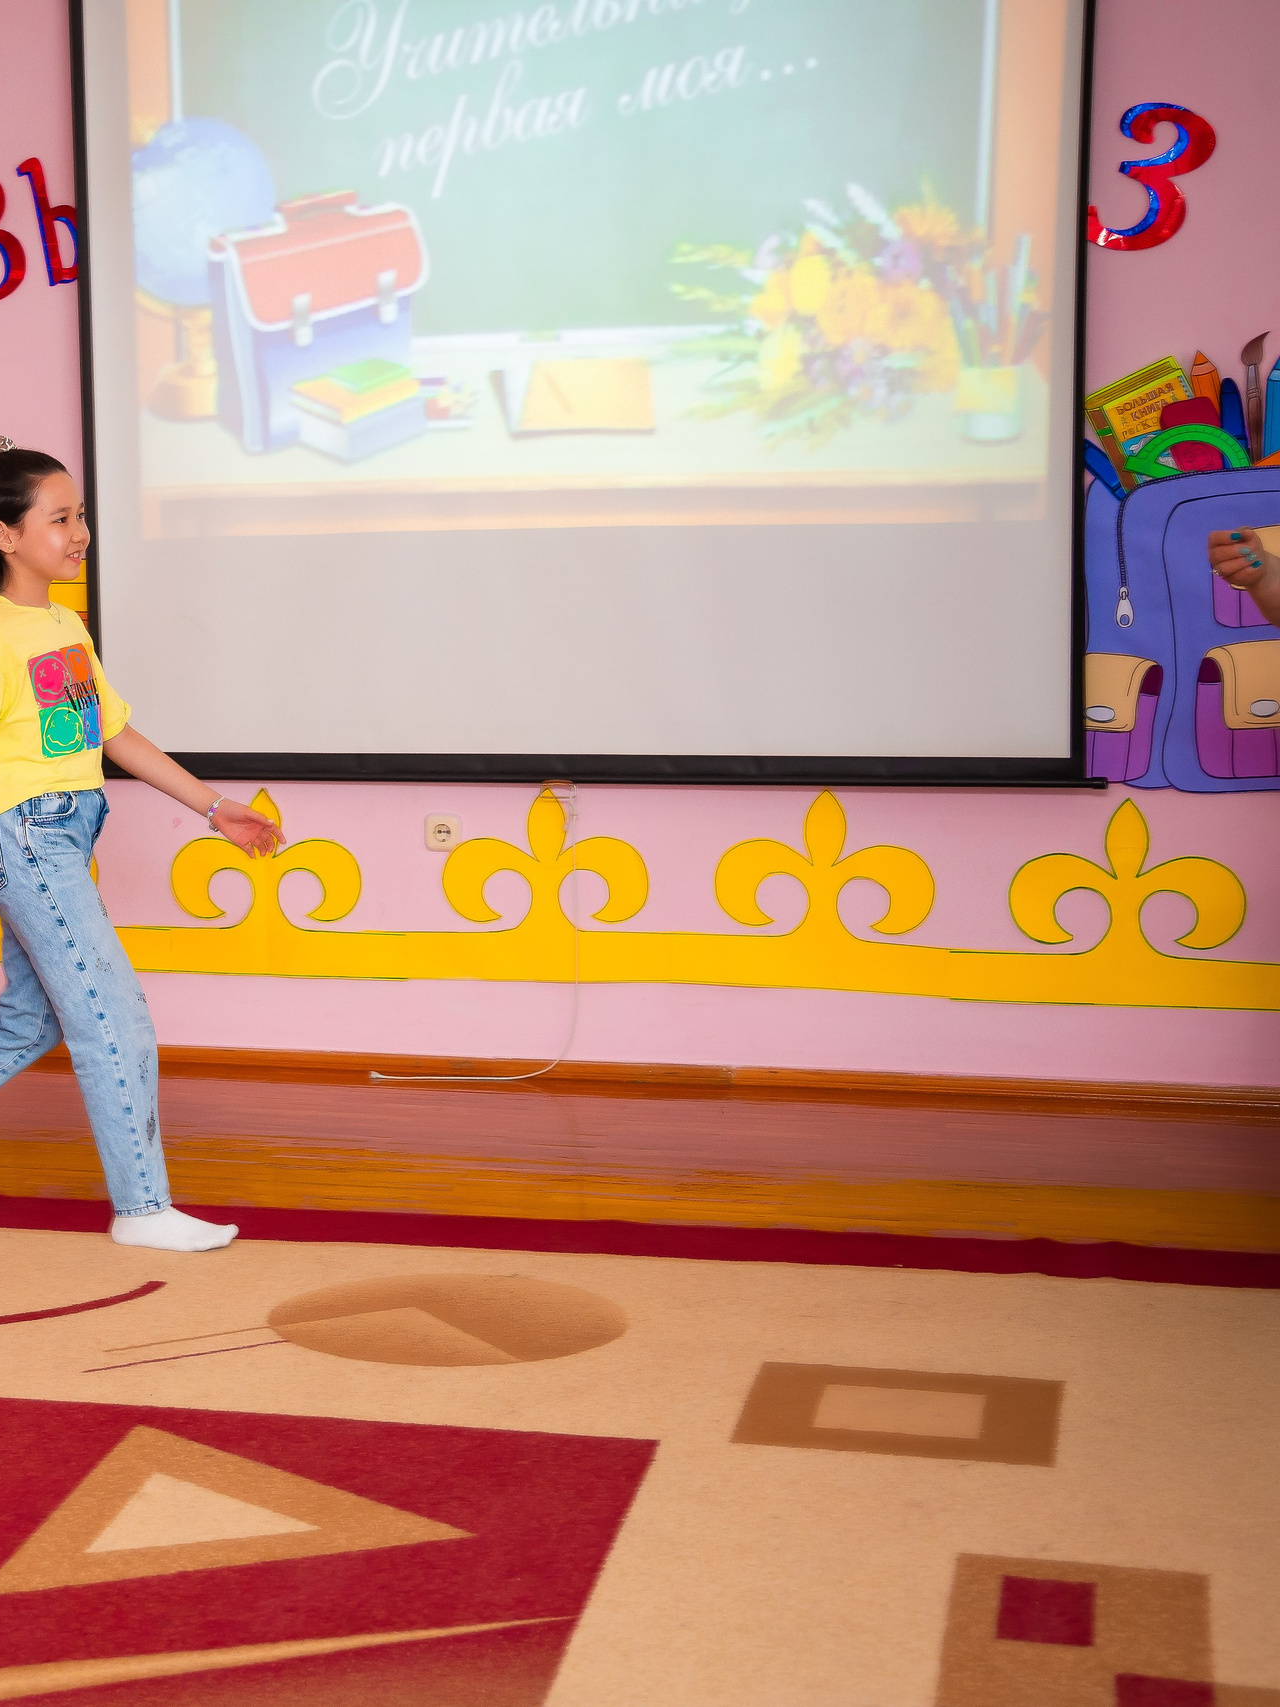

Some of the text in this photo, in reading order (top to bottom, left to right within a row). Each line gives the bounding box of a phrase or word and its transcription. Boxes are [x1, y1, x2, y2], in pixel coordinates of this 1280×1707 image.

[377, 59, 592, 199] первая
[1116, 382, 1175, 415] БОЛЬШАЯ
[1130, 399, 1169, 421] КНИГА
